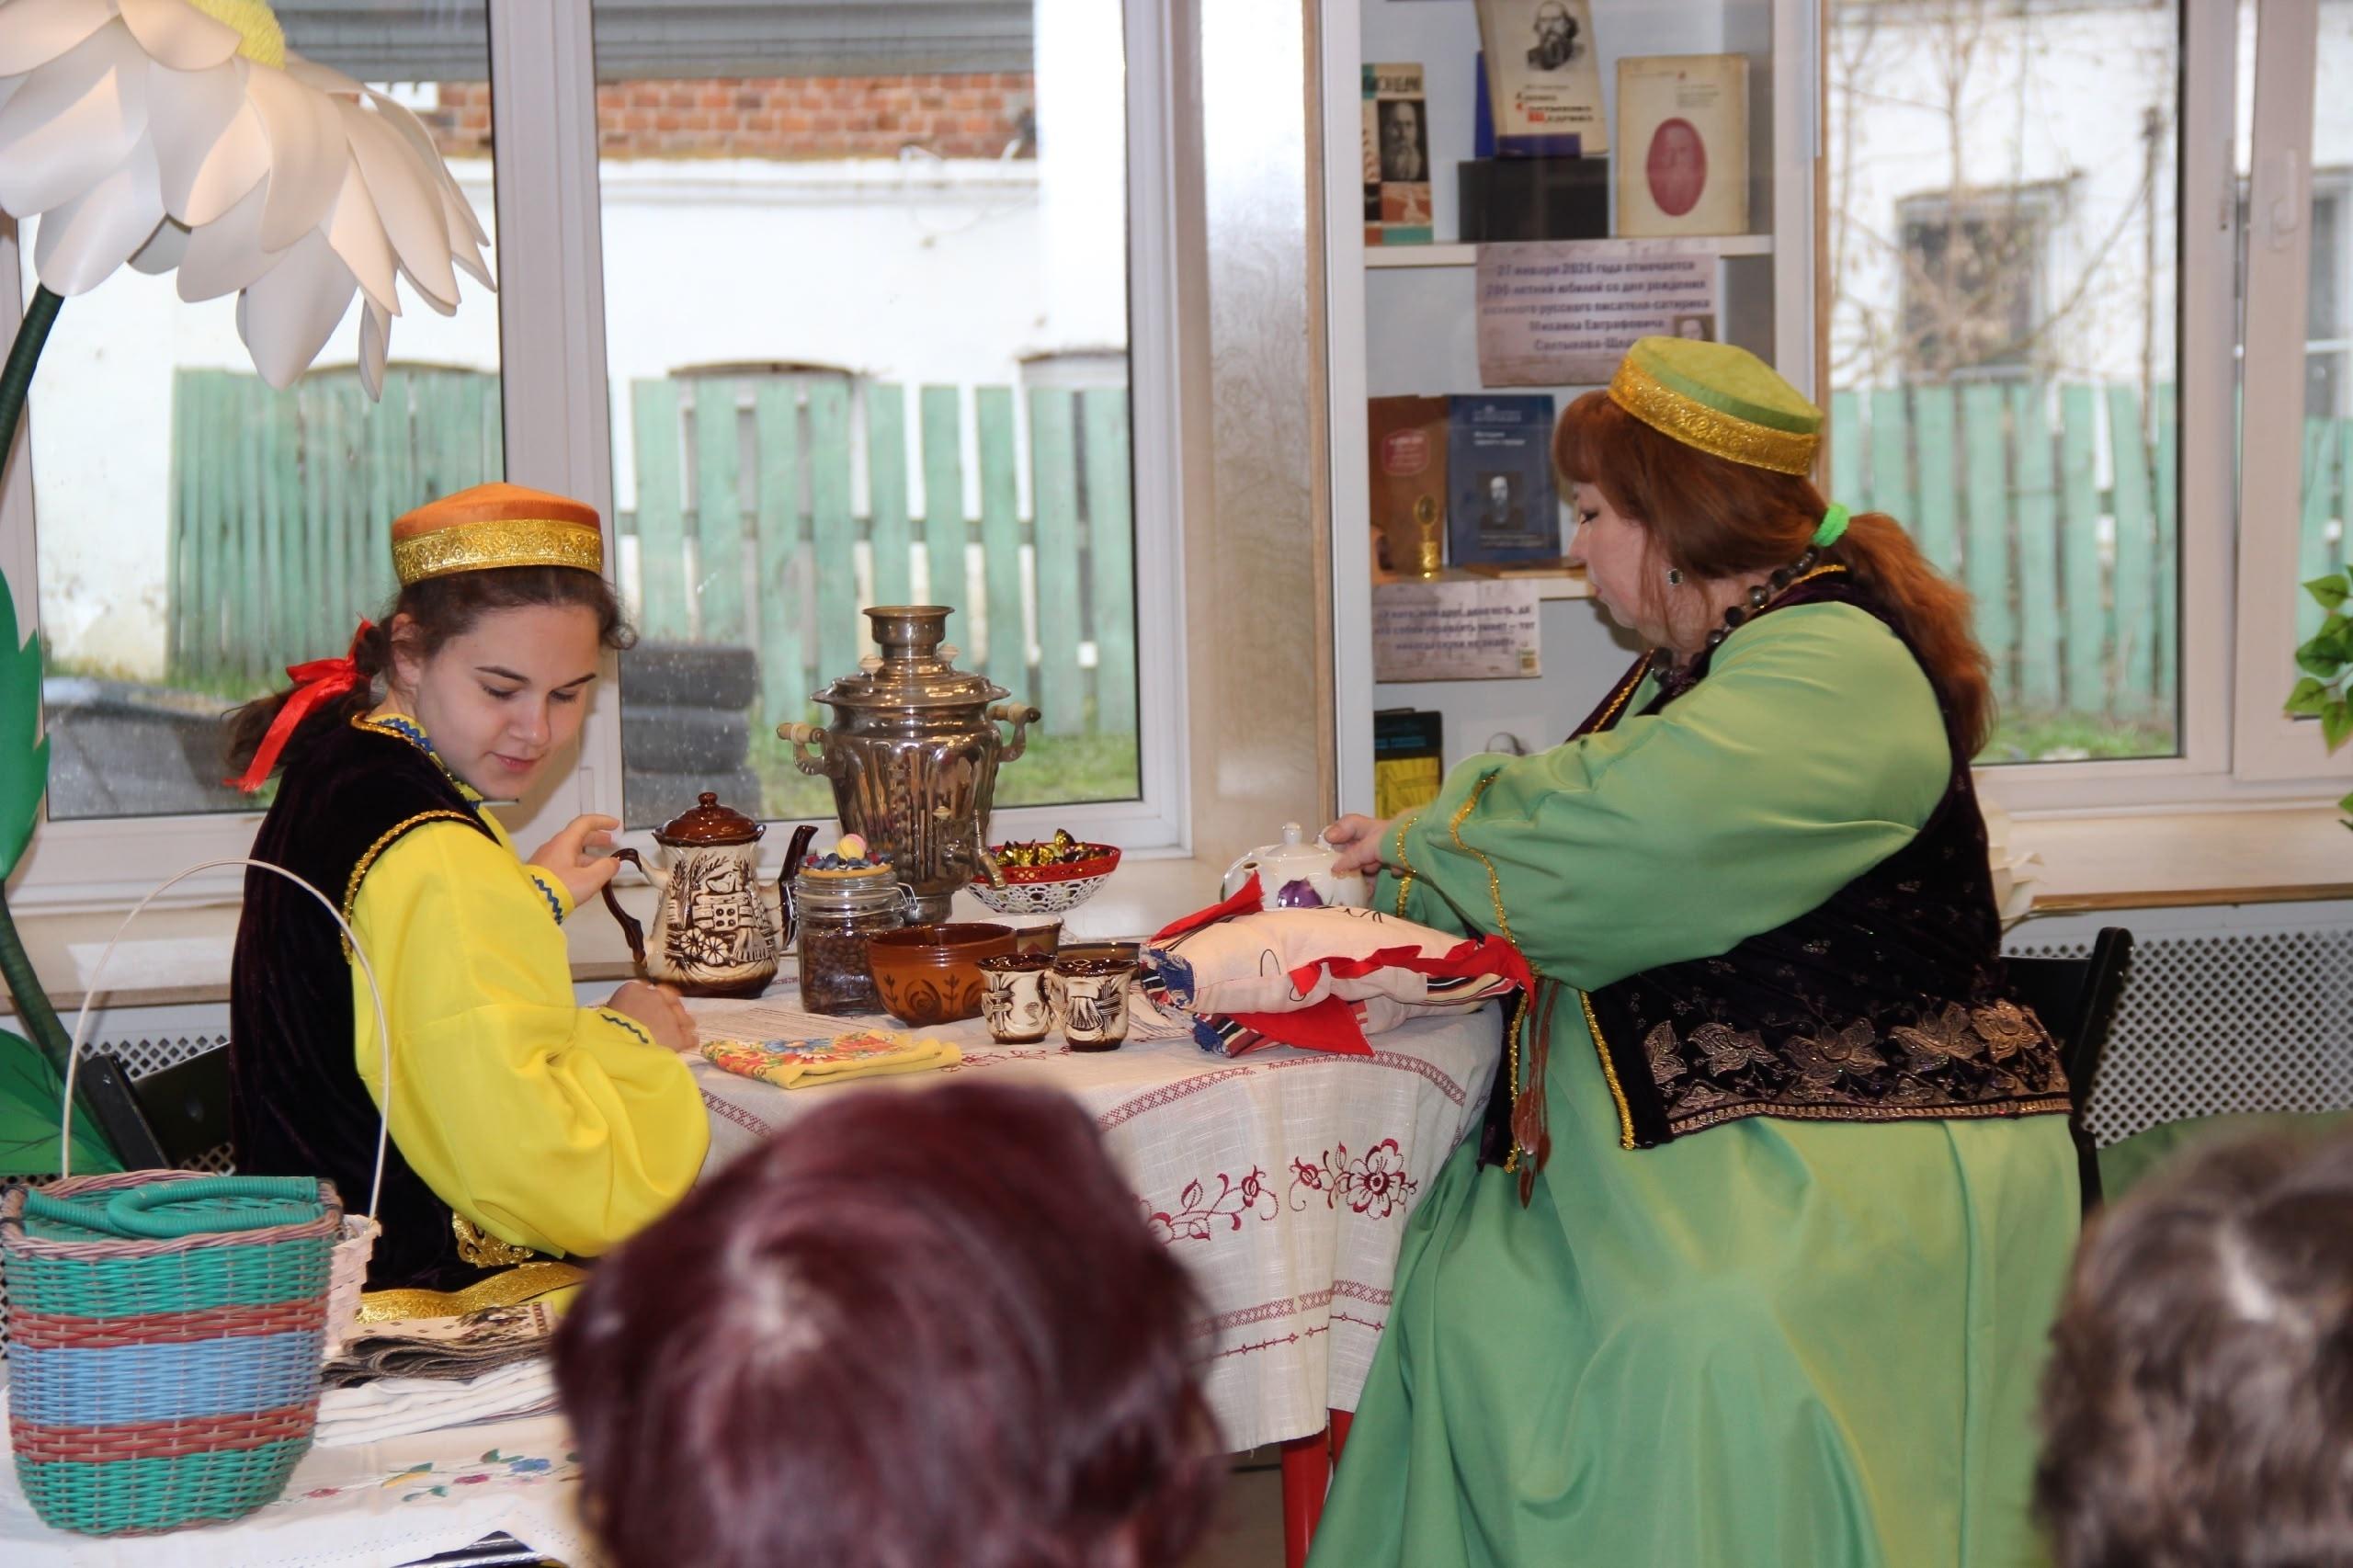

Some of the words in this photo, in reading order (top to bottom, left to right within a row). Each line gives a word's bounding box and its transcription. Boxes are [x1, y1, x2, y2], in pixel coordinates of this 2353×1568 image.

[1515, 266, 1560, 277] января
[1596, 263, 1622, 274] года
[1625, 261, 1695, 272] отмечается
[1558, 280, 1602, 294] юбилей
[1606, 283, 1620, 292] со
[1622, 282, 1643, 293] дня
[1646, 278, 1706, 291] рождения
[1539, 303, 1591, 315] русского
[1595, 299, 1711, 312] писателя-сатирика
[1529, 321, 1582, 331] Михаила
[1585, 319, 1665, 331] Евграфовича
